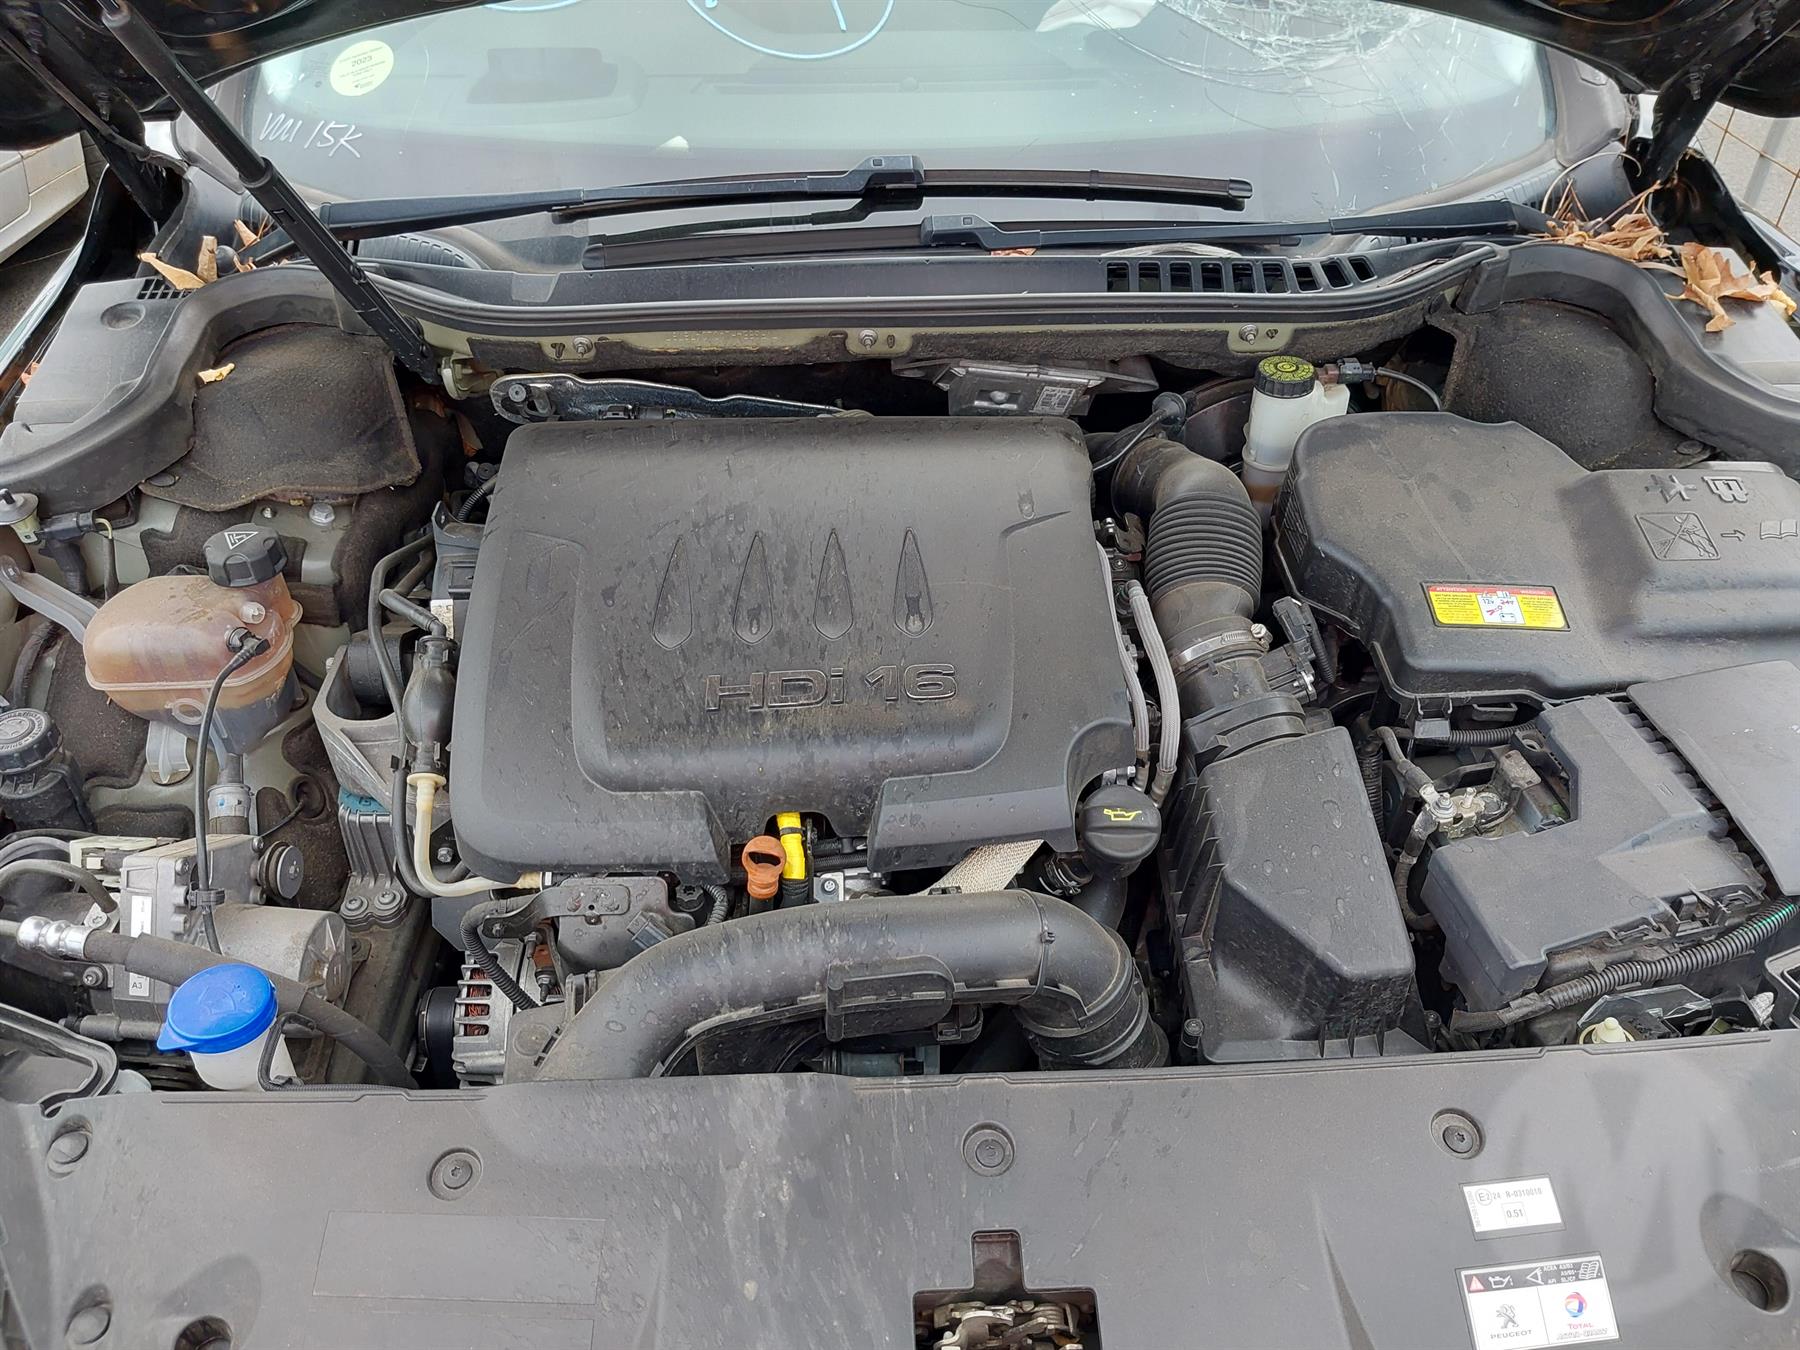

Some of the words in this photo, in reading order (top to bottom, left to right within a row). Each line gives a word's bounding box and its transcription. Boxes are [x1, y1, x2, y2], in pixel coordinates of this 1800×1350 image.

[352, 55, 373, 67] 2023
[704, 667, 845, 713] HDi
[863, 663, 958, 703] 16
[131, 981, 143, 990] A3
[1568, 1322, 1593, 1330] TOTAL
[1490, 1329, 1532, 1339] PEUGEOT
